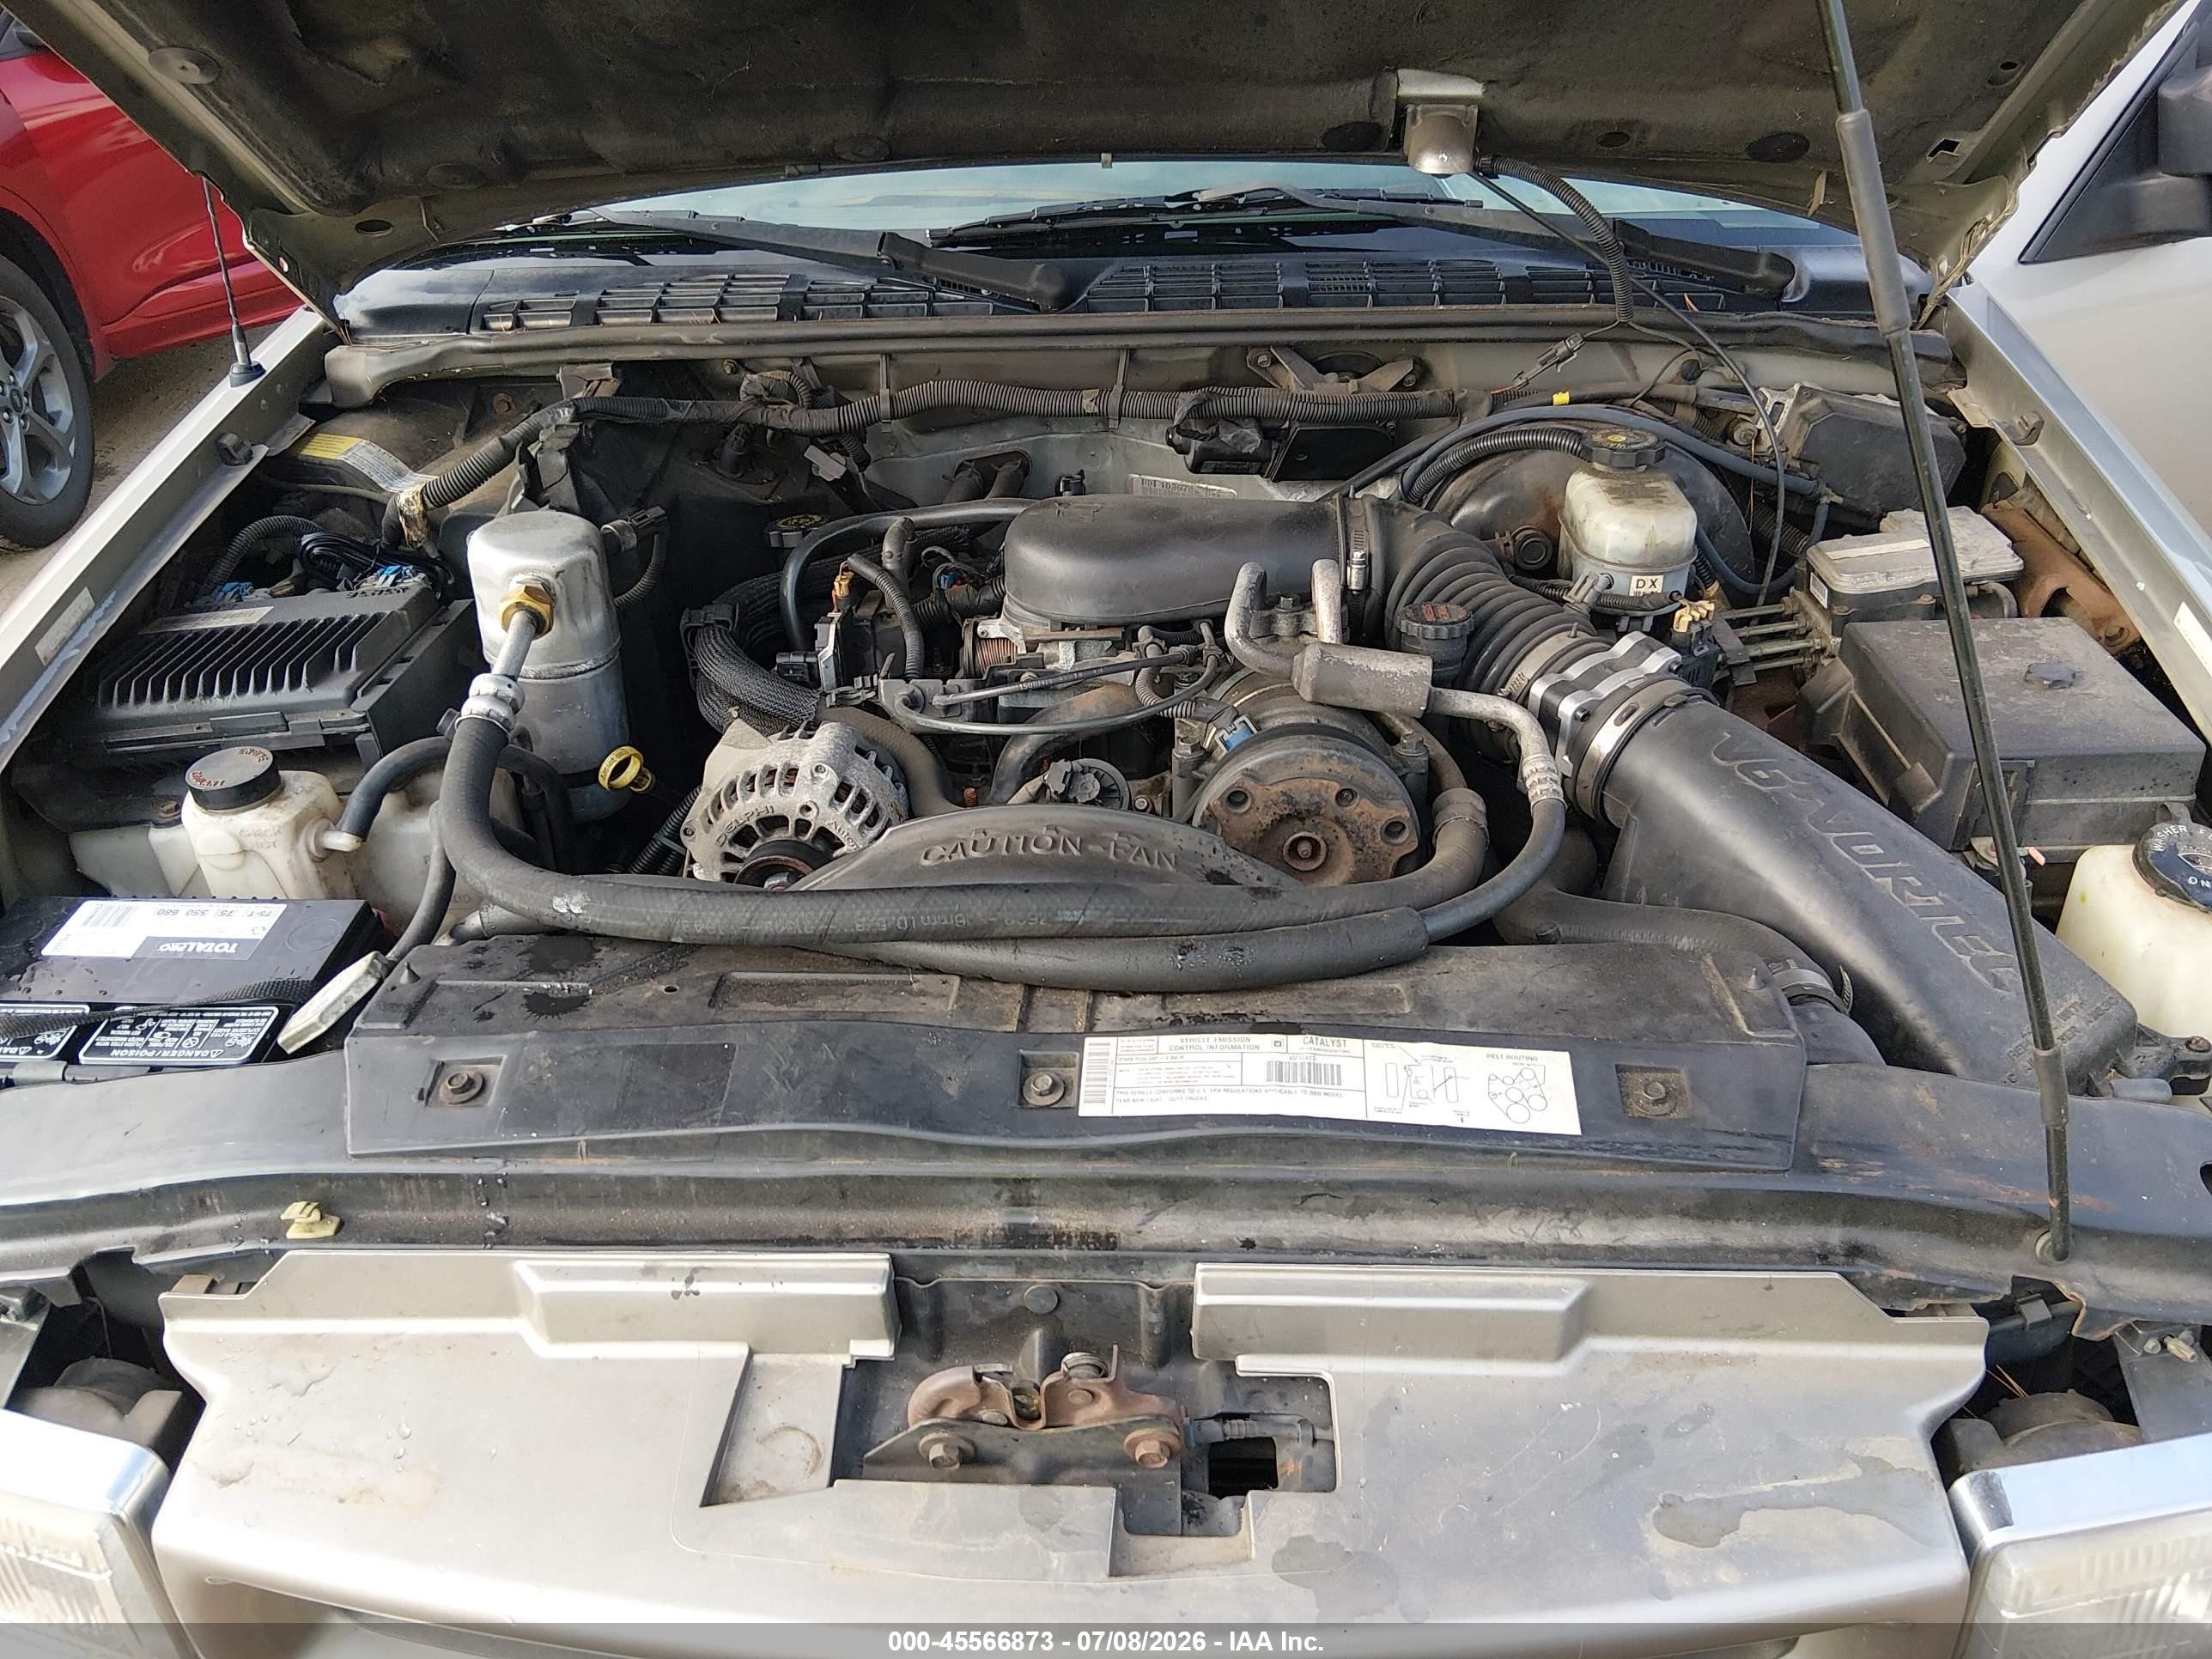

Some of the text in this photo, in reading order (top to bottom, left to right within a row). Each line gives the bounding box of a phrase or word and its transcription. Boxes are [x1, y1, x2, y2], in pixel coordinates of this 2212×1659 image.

[1711, 731, 1807, 793] V6
[716, 805, 775, 848] DELPHI
[2148, 824, 2189, 852] WASHER
[920, 830, 1084, 866] CAUTION
[1109, 835, 1177, 872] FAN
[2187, 876, 2212, 890] ON
[158, 942, 240, 954] TOTALPRO
[1303, 1036, 1347, 1048] CATALYST
